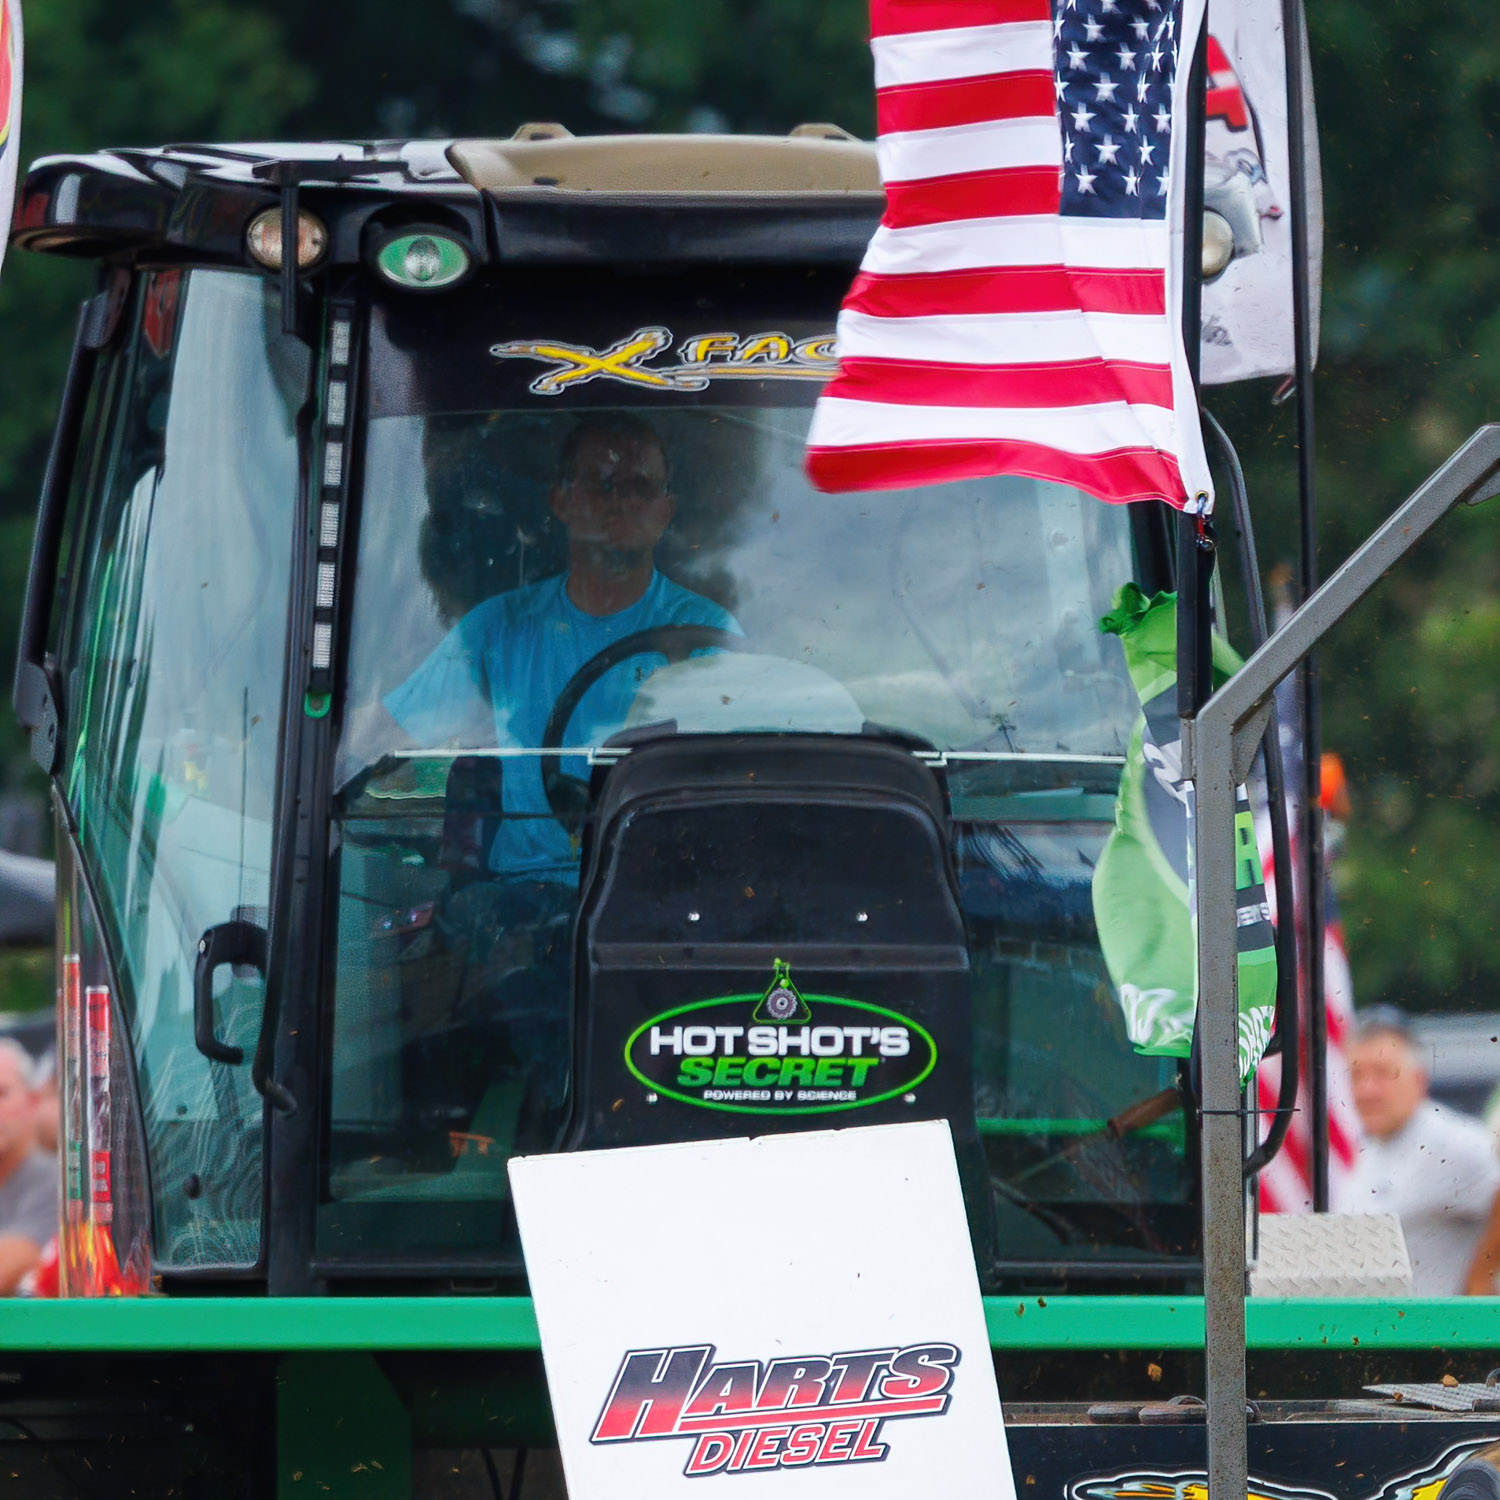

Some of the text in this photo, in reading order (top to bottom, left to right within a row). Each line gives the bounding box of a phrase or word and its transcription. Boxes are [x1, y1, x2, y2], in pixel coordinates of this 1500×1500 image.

[650, 1026, 911, 1056] HOT SHOT'S
[677, 1057, 880, 1087] SECRET
[703, 1090, 857, 1100] POWERED BY SCIENCE
[683, 1418, 891, 1479] DIESEL
